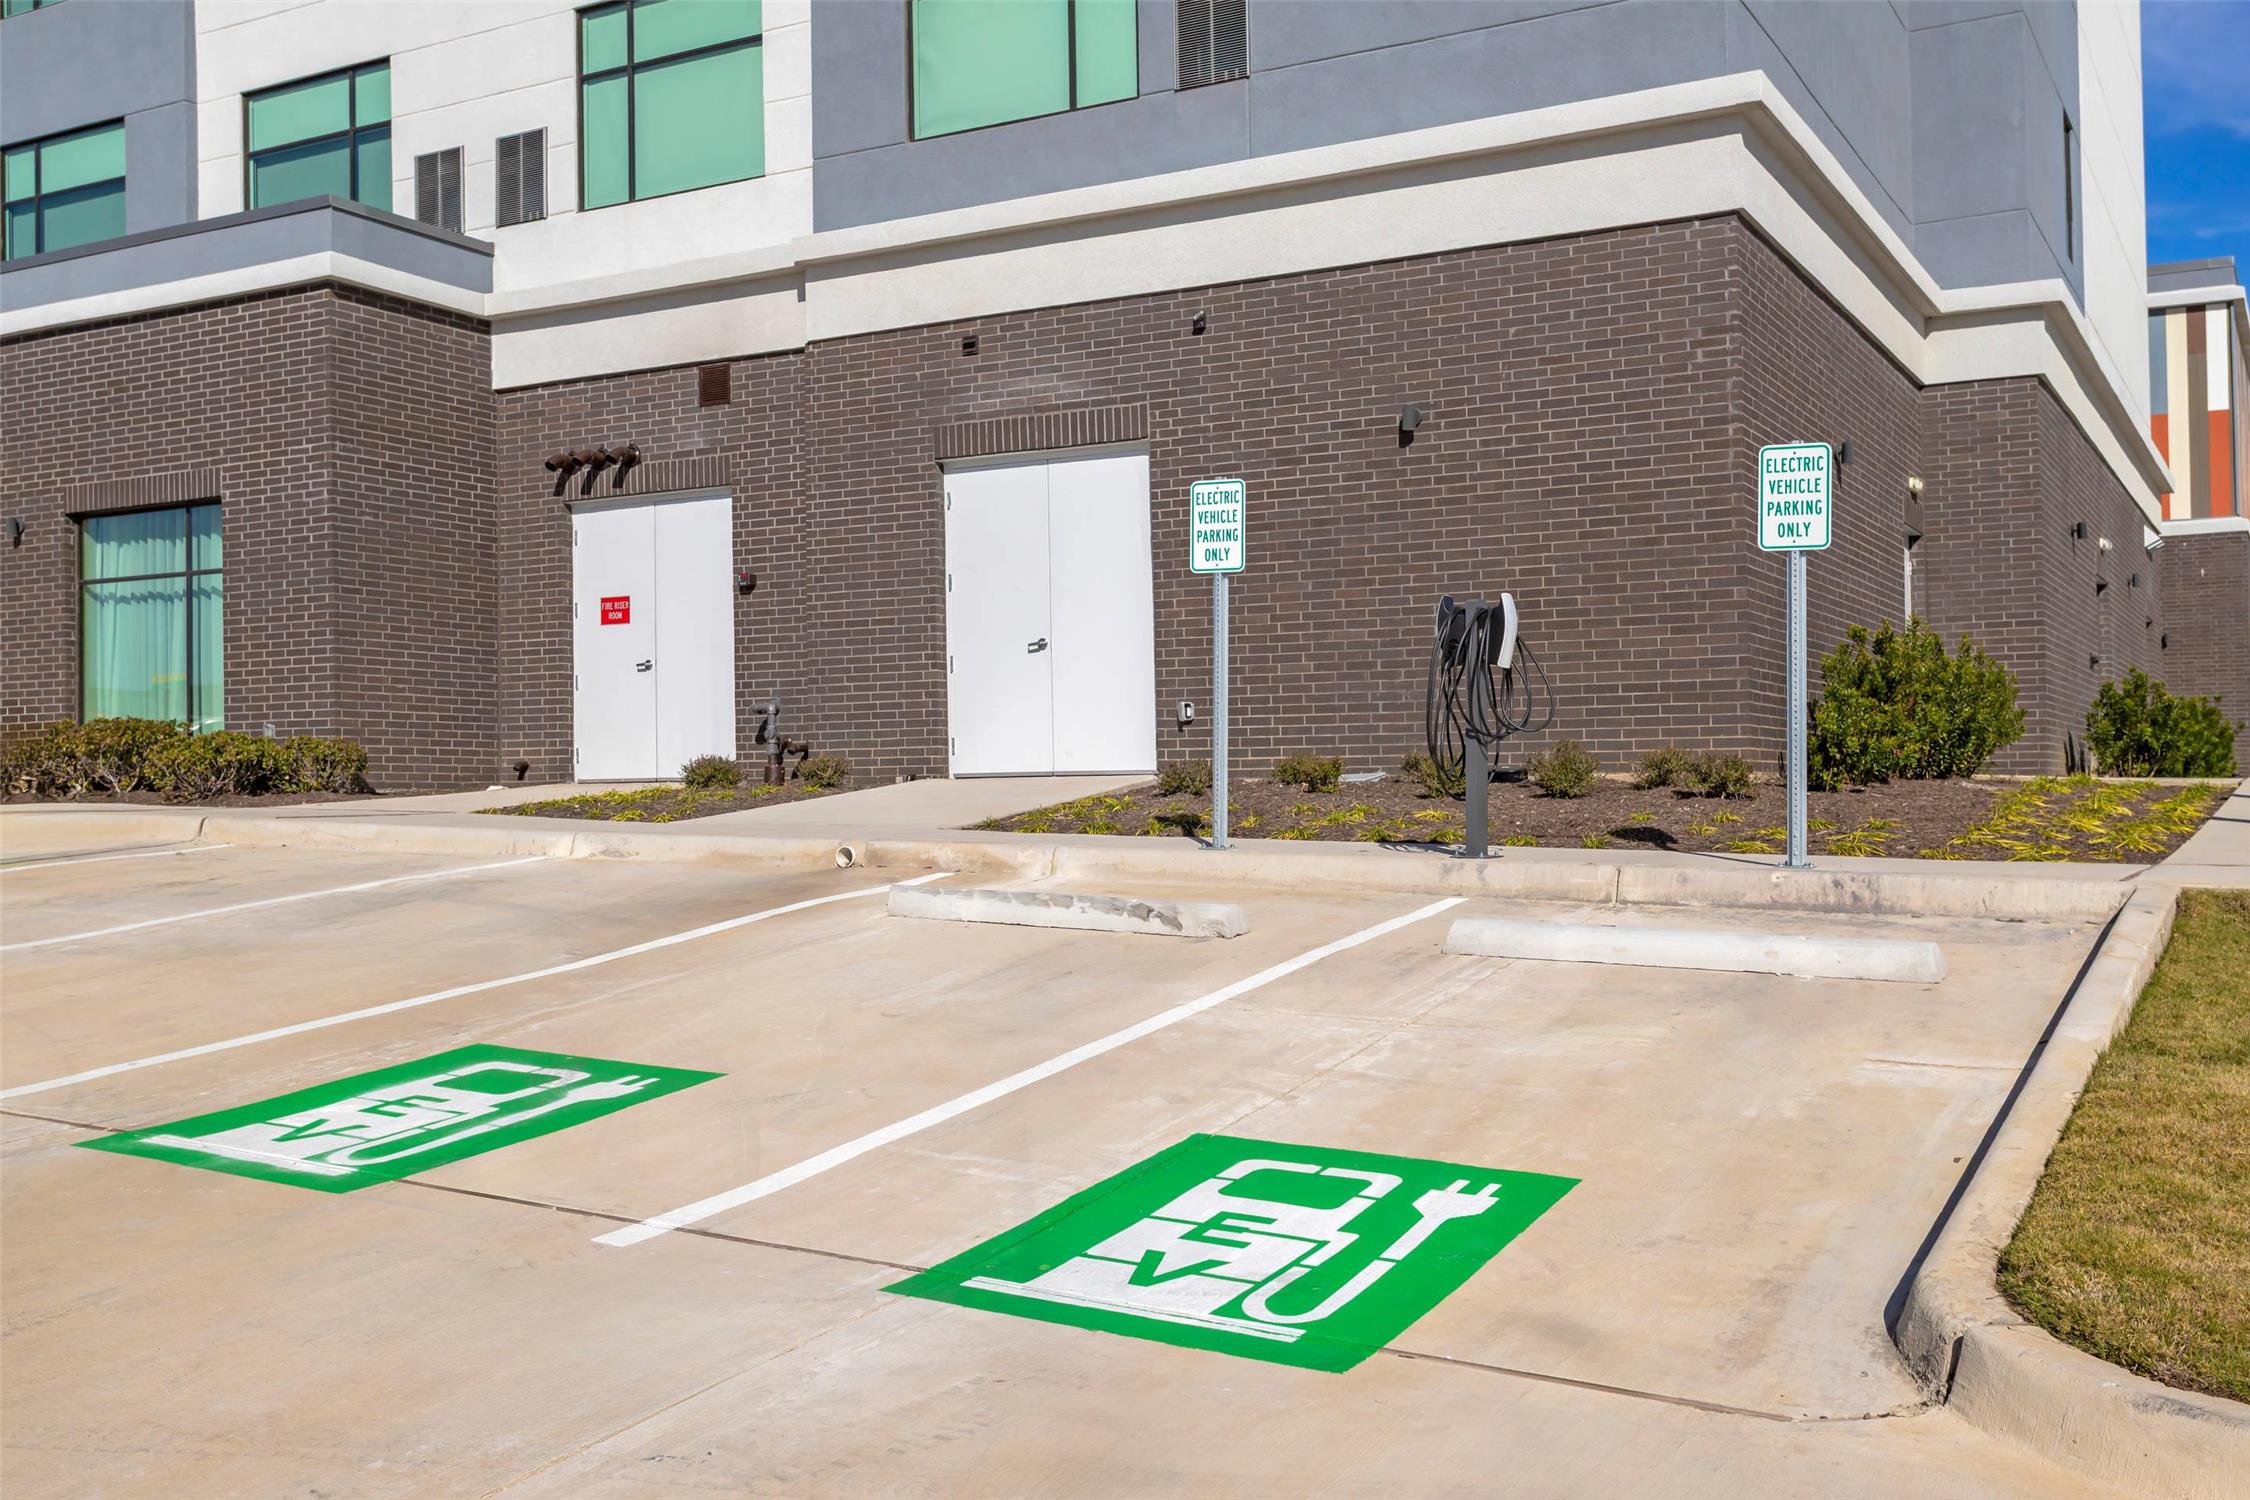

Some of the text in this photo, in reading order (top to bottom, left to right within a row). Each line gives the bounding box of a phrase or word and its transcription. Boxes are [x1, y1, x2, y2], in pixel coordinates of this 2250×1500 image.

[1766, 456, 1824, 473] ELECTRIC
[1769, 478, 1822, 495] VEHICLE
[1196, 490, 1240, 506] ELECTRIC
[1198, 509, 1238, 524] VEHICLE
[1767, 500, 1822, 517] PARKING
[1197, 528, 1239, 543] PARKING
[1777, 522, 1811, 538] ONLY
[1204, 547, 1231, 562] ONLY
[602, 602, 613, 610] FIRE
